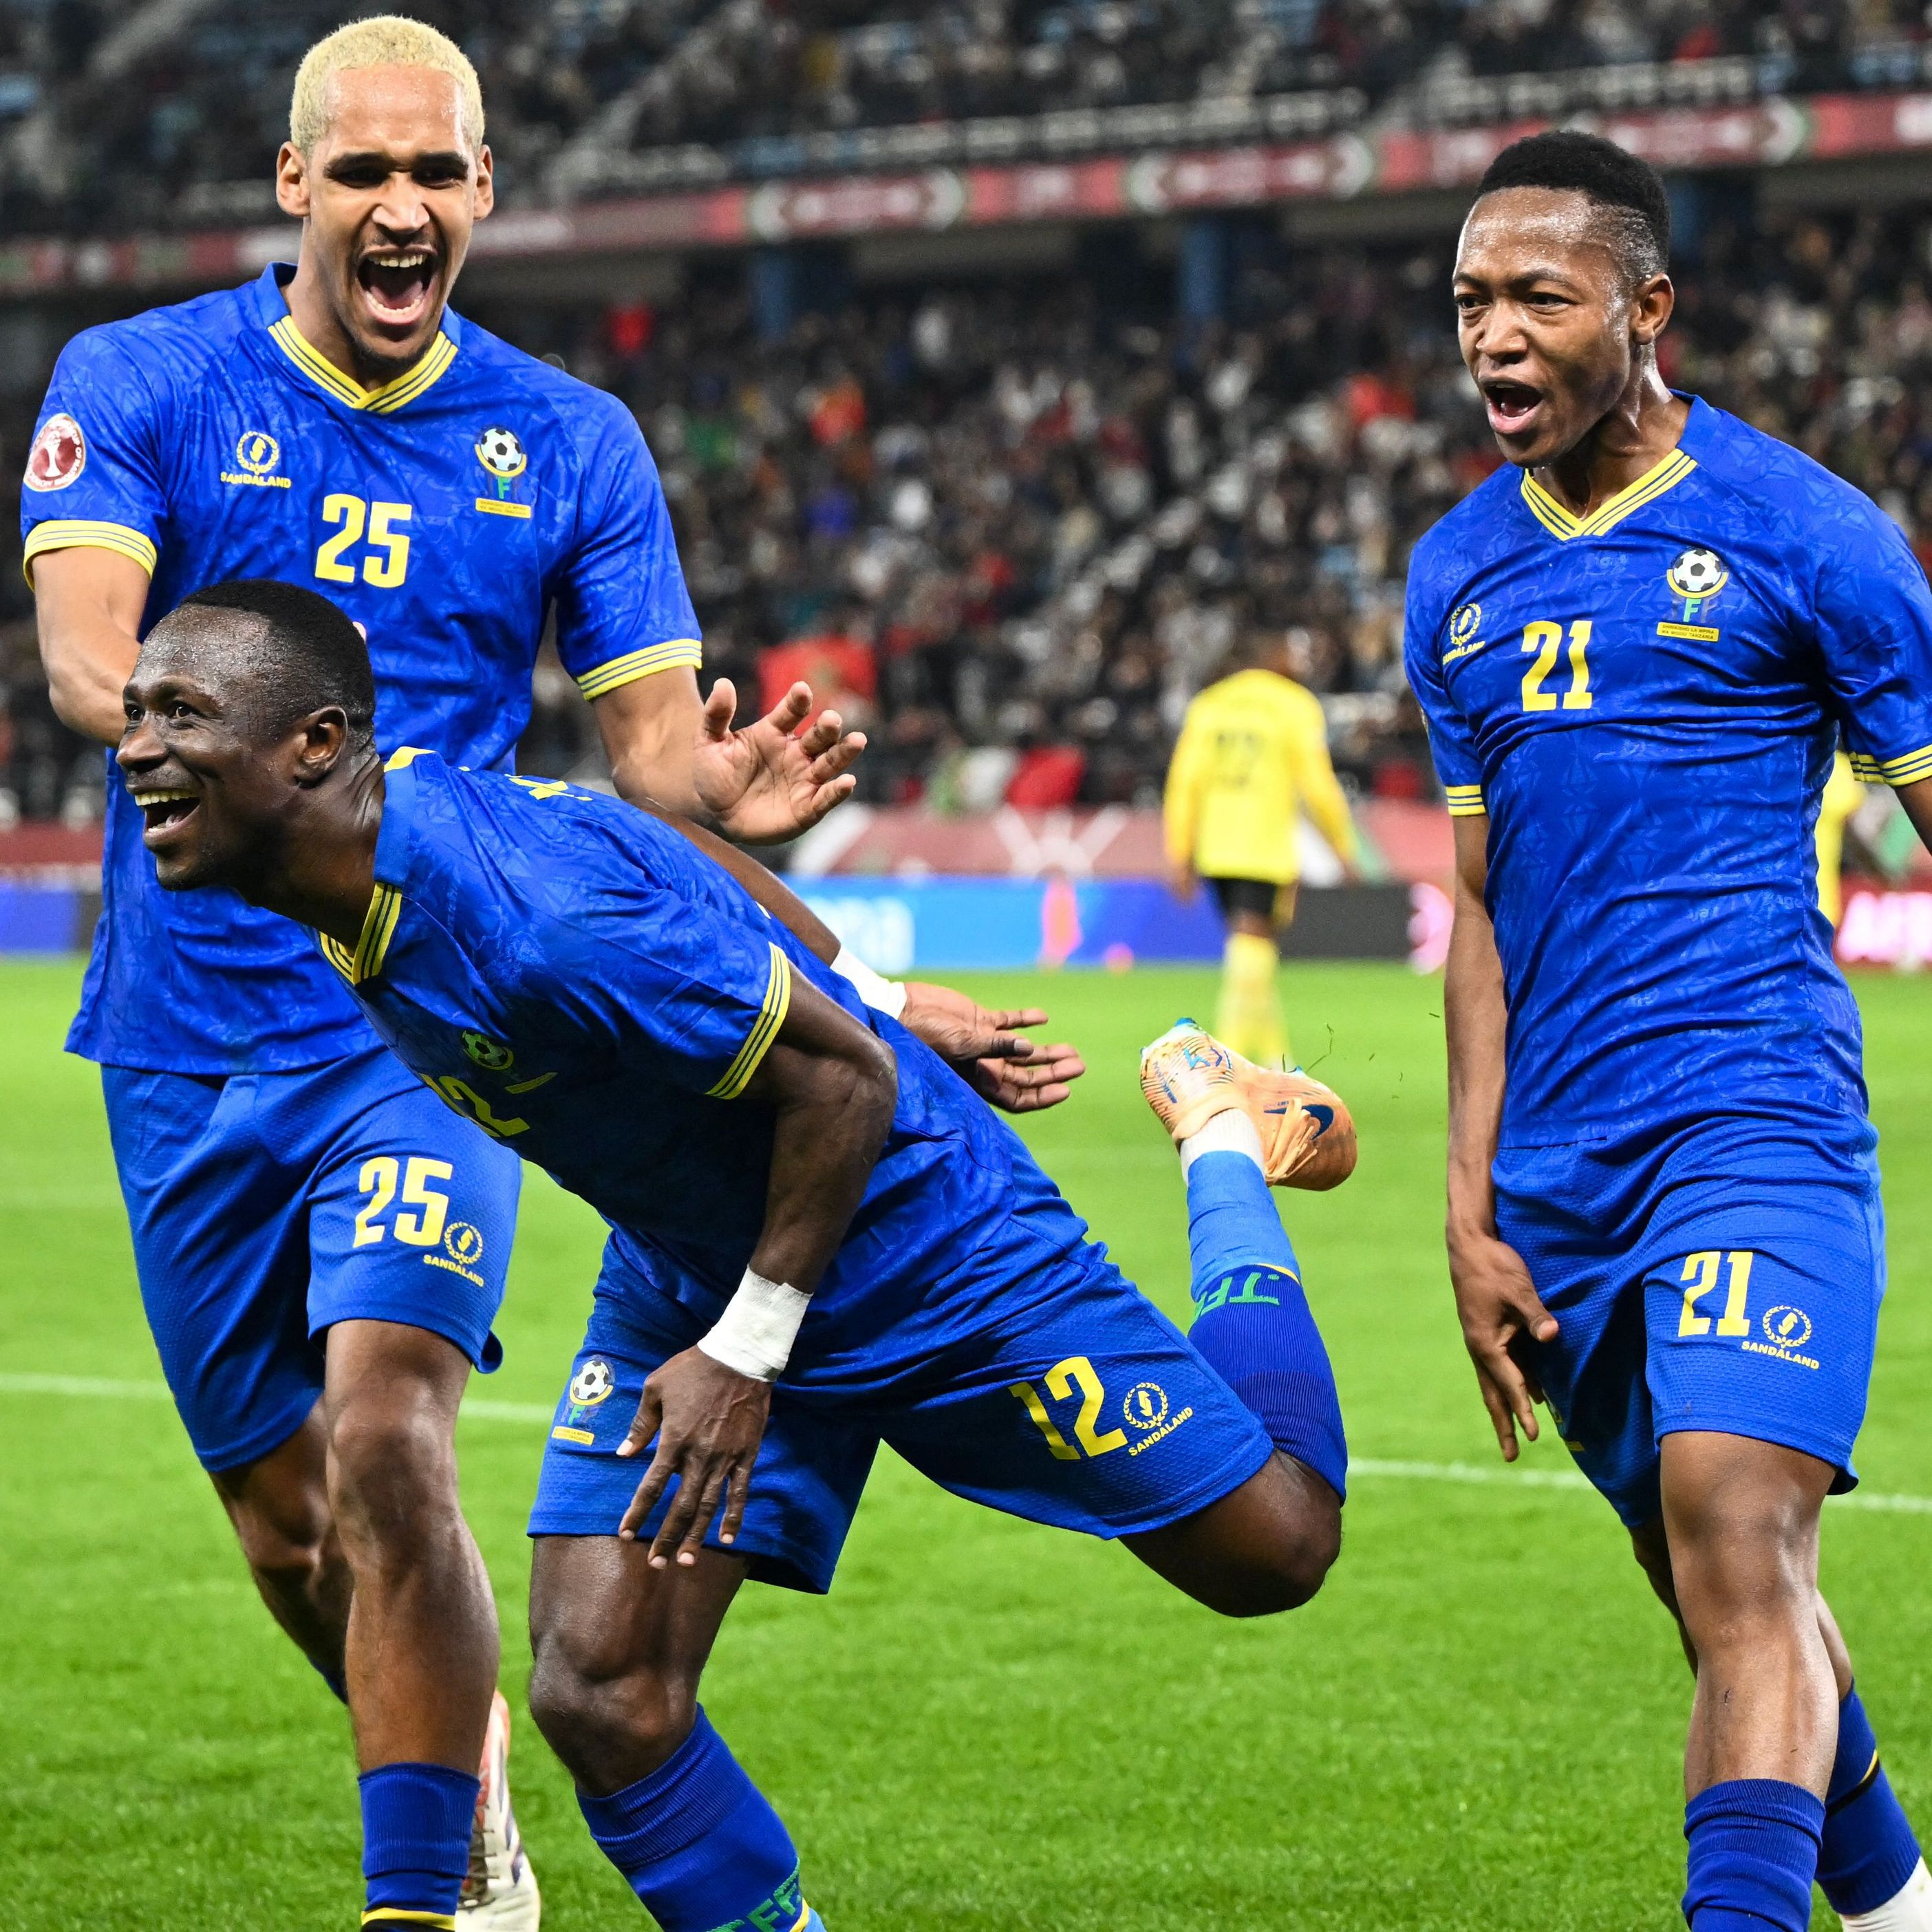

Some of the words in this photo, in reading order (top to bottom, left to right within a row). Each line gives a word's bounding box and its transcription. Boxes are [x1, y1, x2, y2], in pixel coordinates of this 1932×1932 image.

[314, 493, 412, 588] 25
[1521, 620, 1593, 711] 21
[353, 1157, 453, 1248] 25
[423, 1254, 484, 1287] SANDALAND
[1677, 1251, 1753, 1338] 21
[1741, 1340, 1820, 1369] SANDALAND
[1008, 1356, 1128, 1460] 12
[1128, 1406, 1194, 1457] SANDALAND
